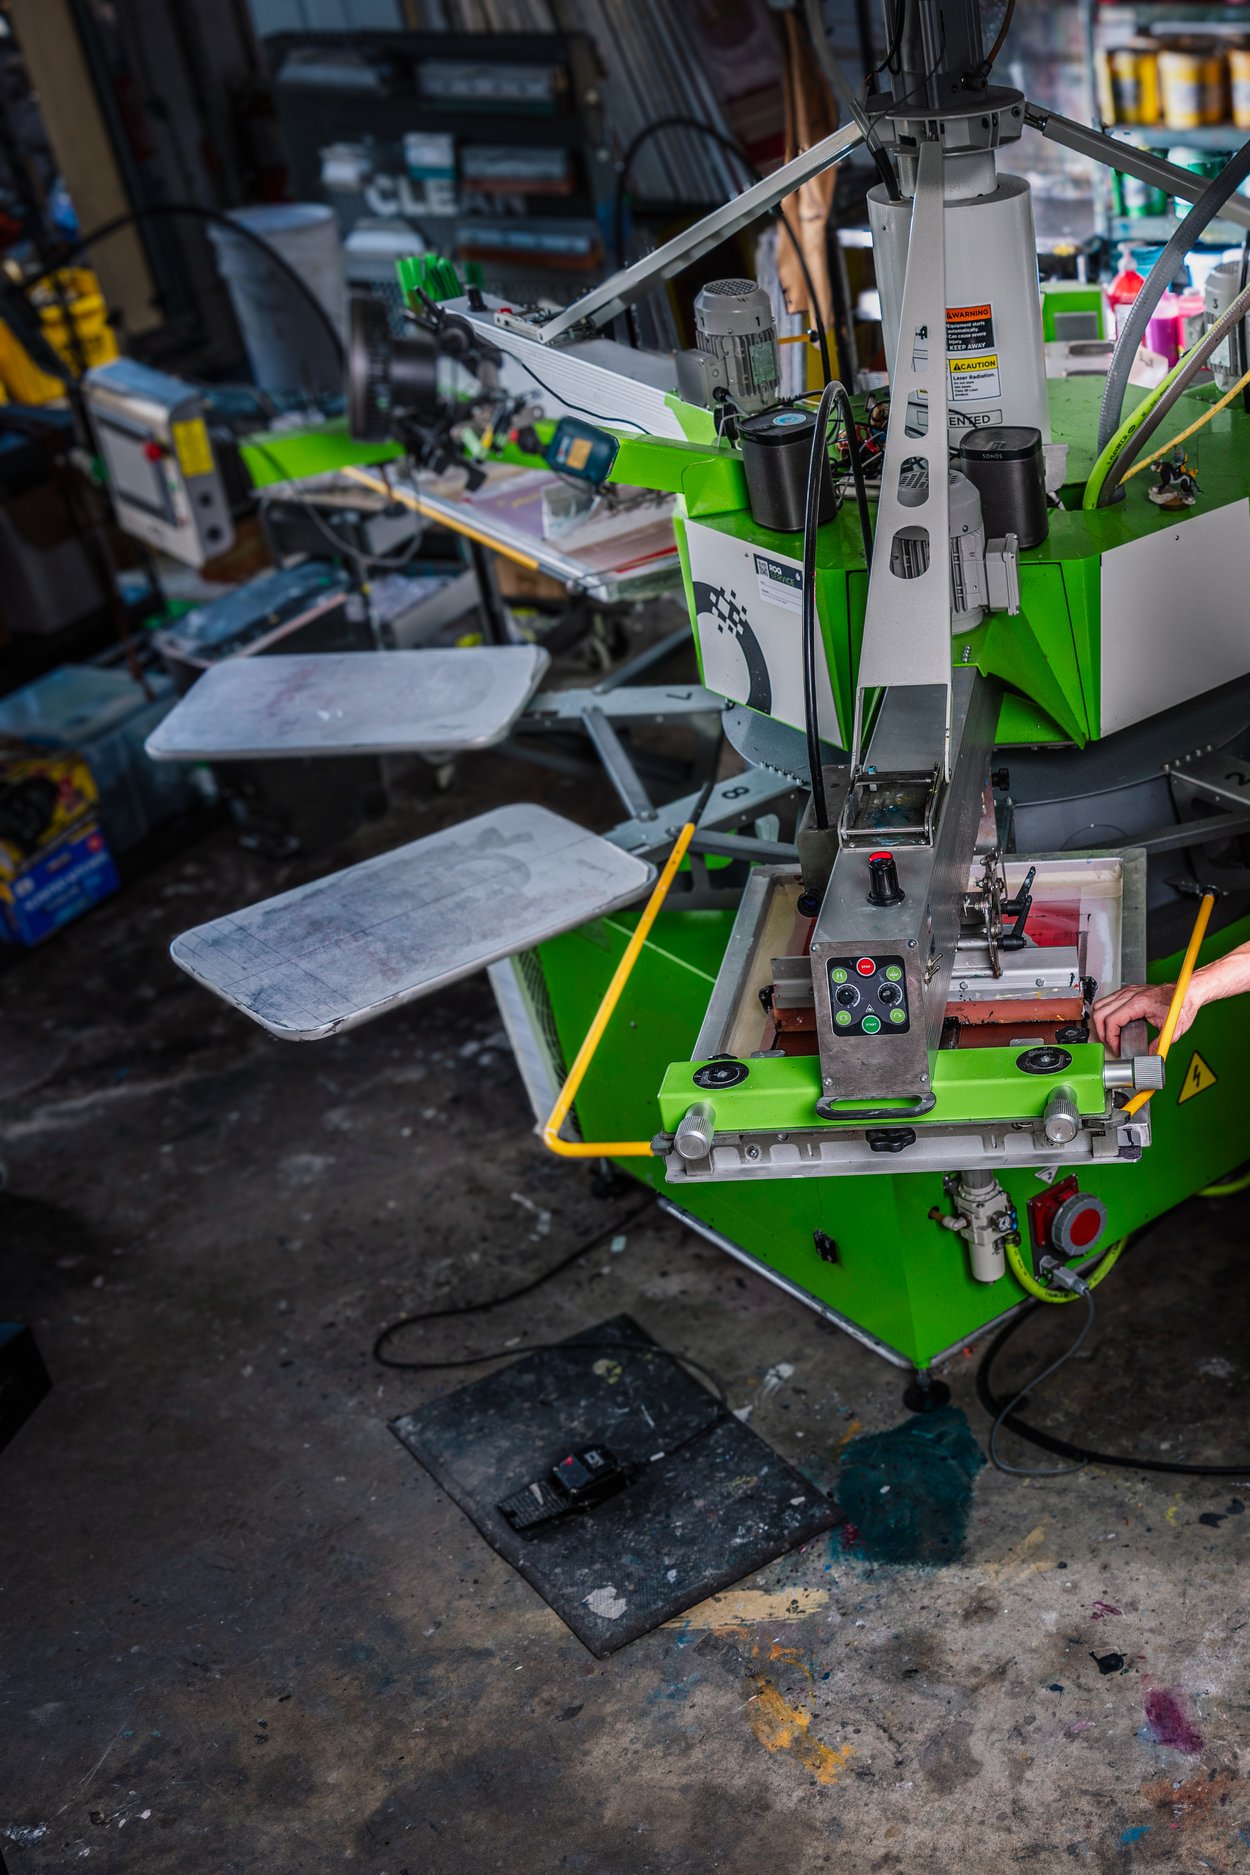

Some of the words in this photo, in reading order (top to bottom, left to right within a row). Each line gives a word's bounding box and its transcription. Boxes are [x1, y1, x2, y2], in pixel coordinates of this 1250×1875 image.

[365, 177, 526, 217] CLEAN
[952, 309, 989, 318] WARNING
[755, 316, 761, 327] 1
[967, 342, 986, 350] AWAY
[960, 360, 996, 370] CAUTION
[949, 414, 991, 426] ENTED
[721, 786, 750, 800] 8
